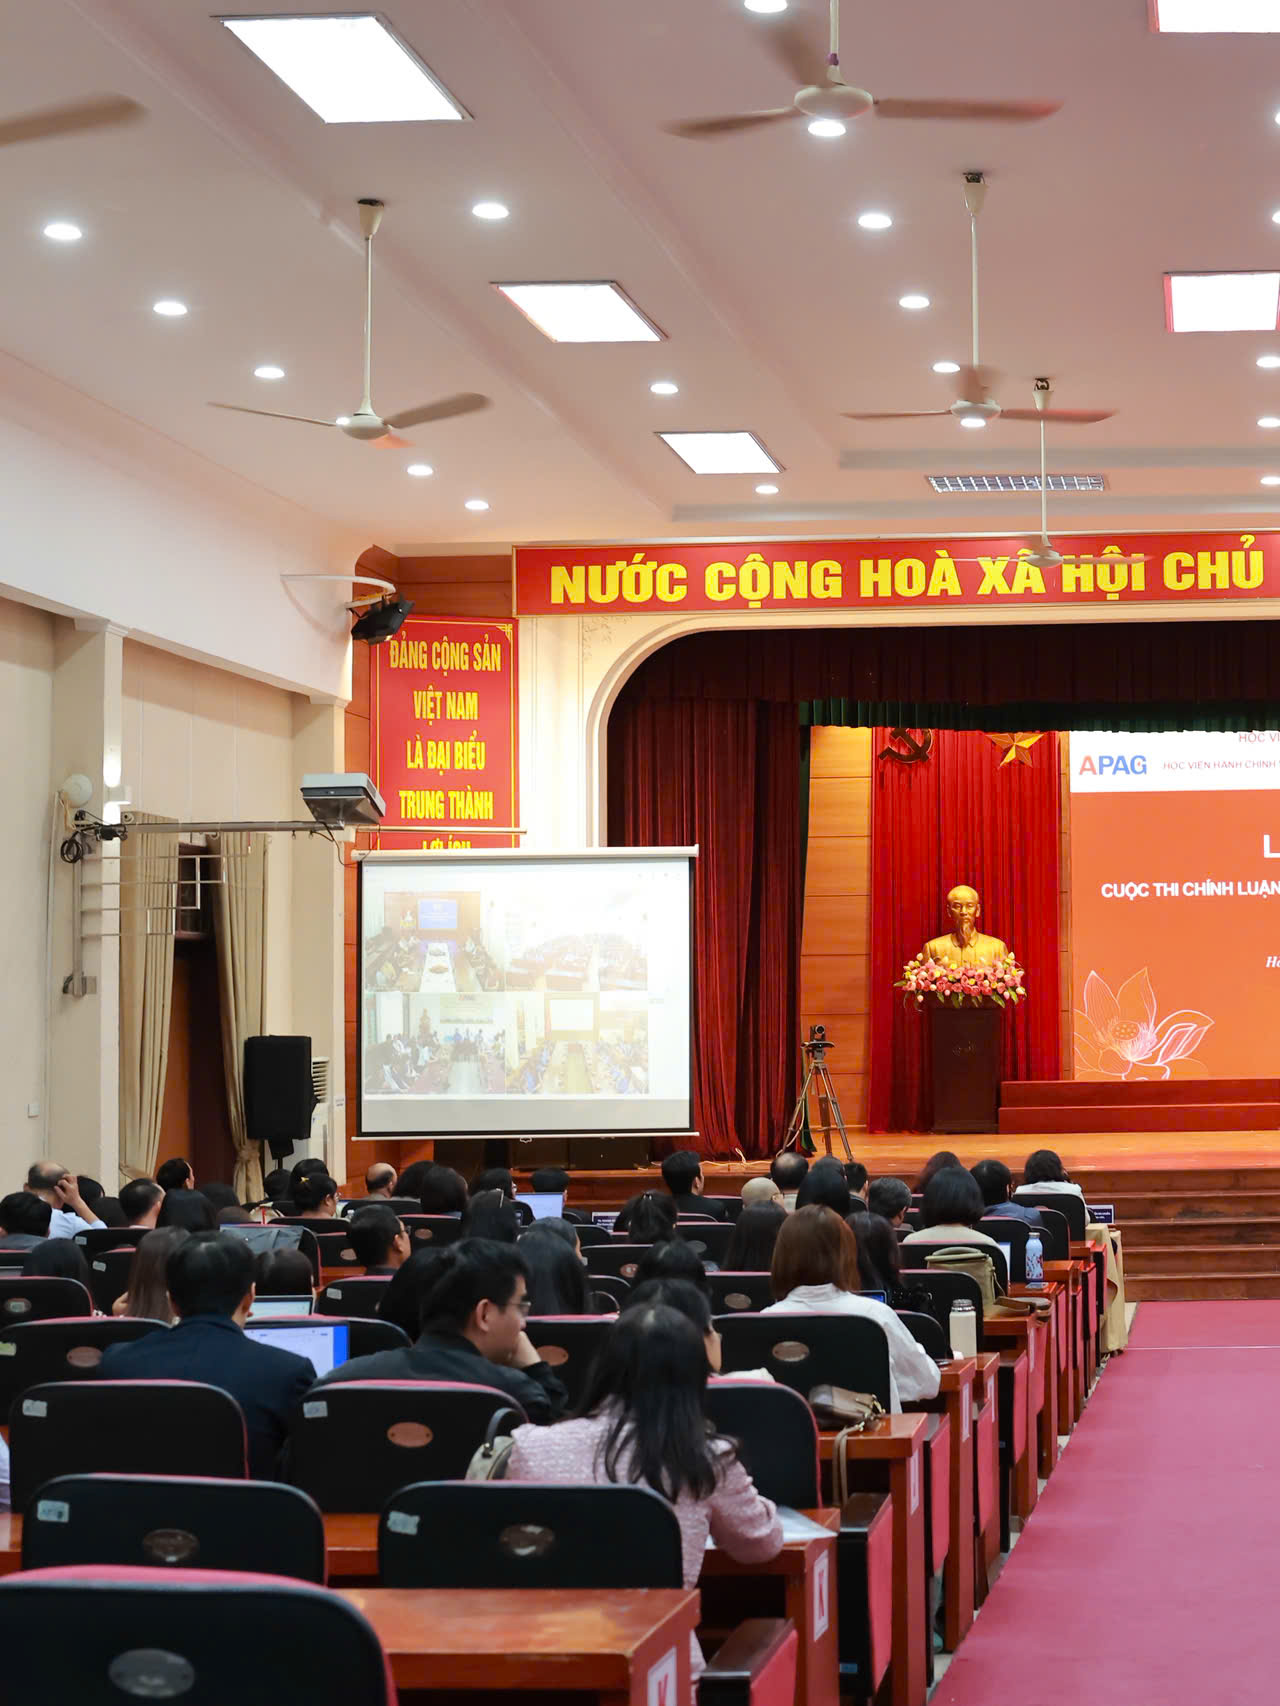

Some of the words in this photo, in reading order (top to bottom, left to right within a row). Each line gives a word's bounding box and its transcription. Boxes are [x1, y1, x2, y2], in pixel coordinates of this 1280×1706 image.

[552, 553, 687, 603] NƯỚC
[705, 554, 842, 608] CỘNG
[861, 550, 961, 597] HOÀ
[1062, 546, 1144, 600] HỘI
[1164, 535, 1263, 590] CHỦ
[390, 631, 428, 669] ĐẢNG
[432, 636, 469, 676] CỘNG
[473, 634, 501, 671] SẢN
[414, 685, 442, 726] VIỆT
[446, 692, 478, 720] NAM
[407, 735, 424, 768] LÀ
[427, 740, 450, 776] ĐẠI
[454, 730, 486, 770] BIỂU
[1079, 755, 1147, 775] APAG
[399, 790, 445, 819] TRUNG
[448, 786, 493, 820] THÀNH
[1102, 882, 1149, 900] CUỘC
[1153, 883, 1179, 896] THI
[1183, 879, 1233, 896] CHÍNH
